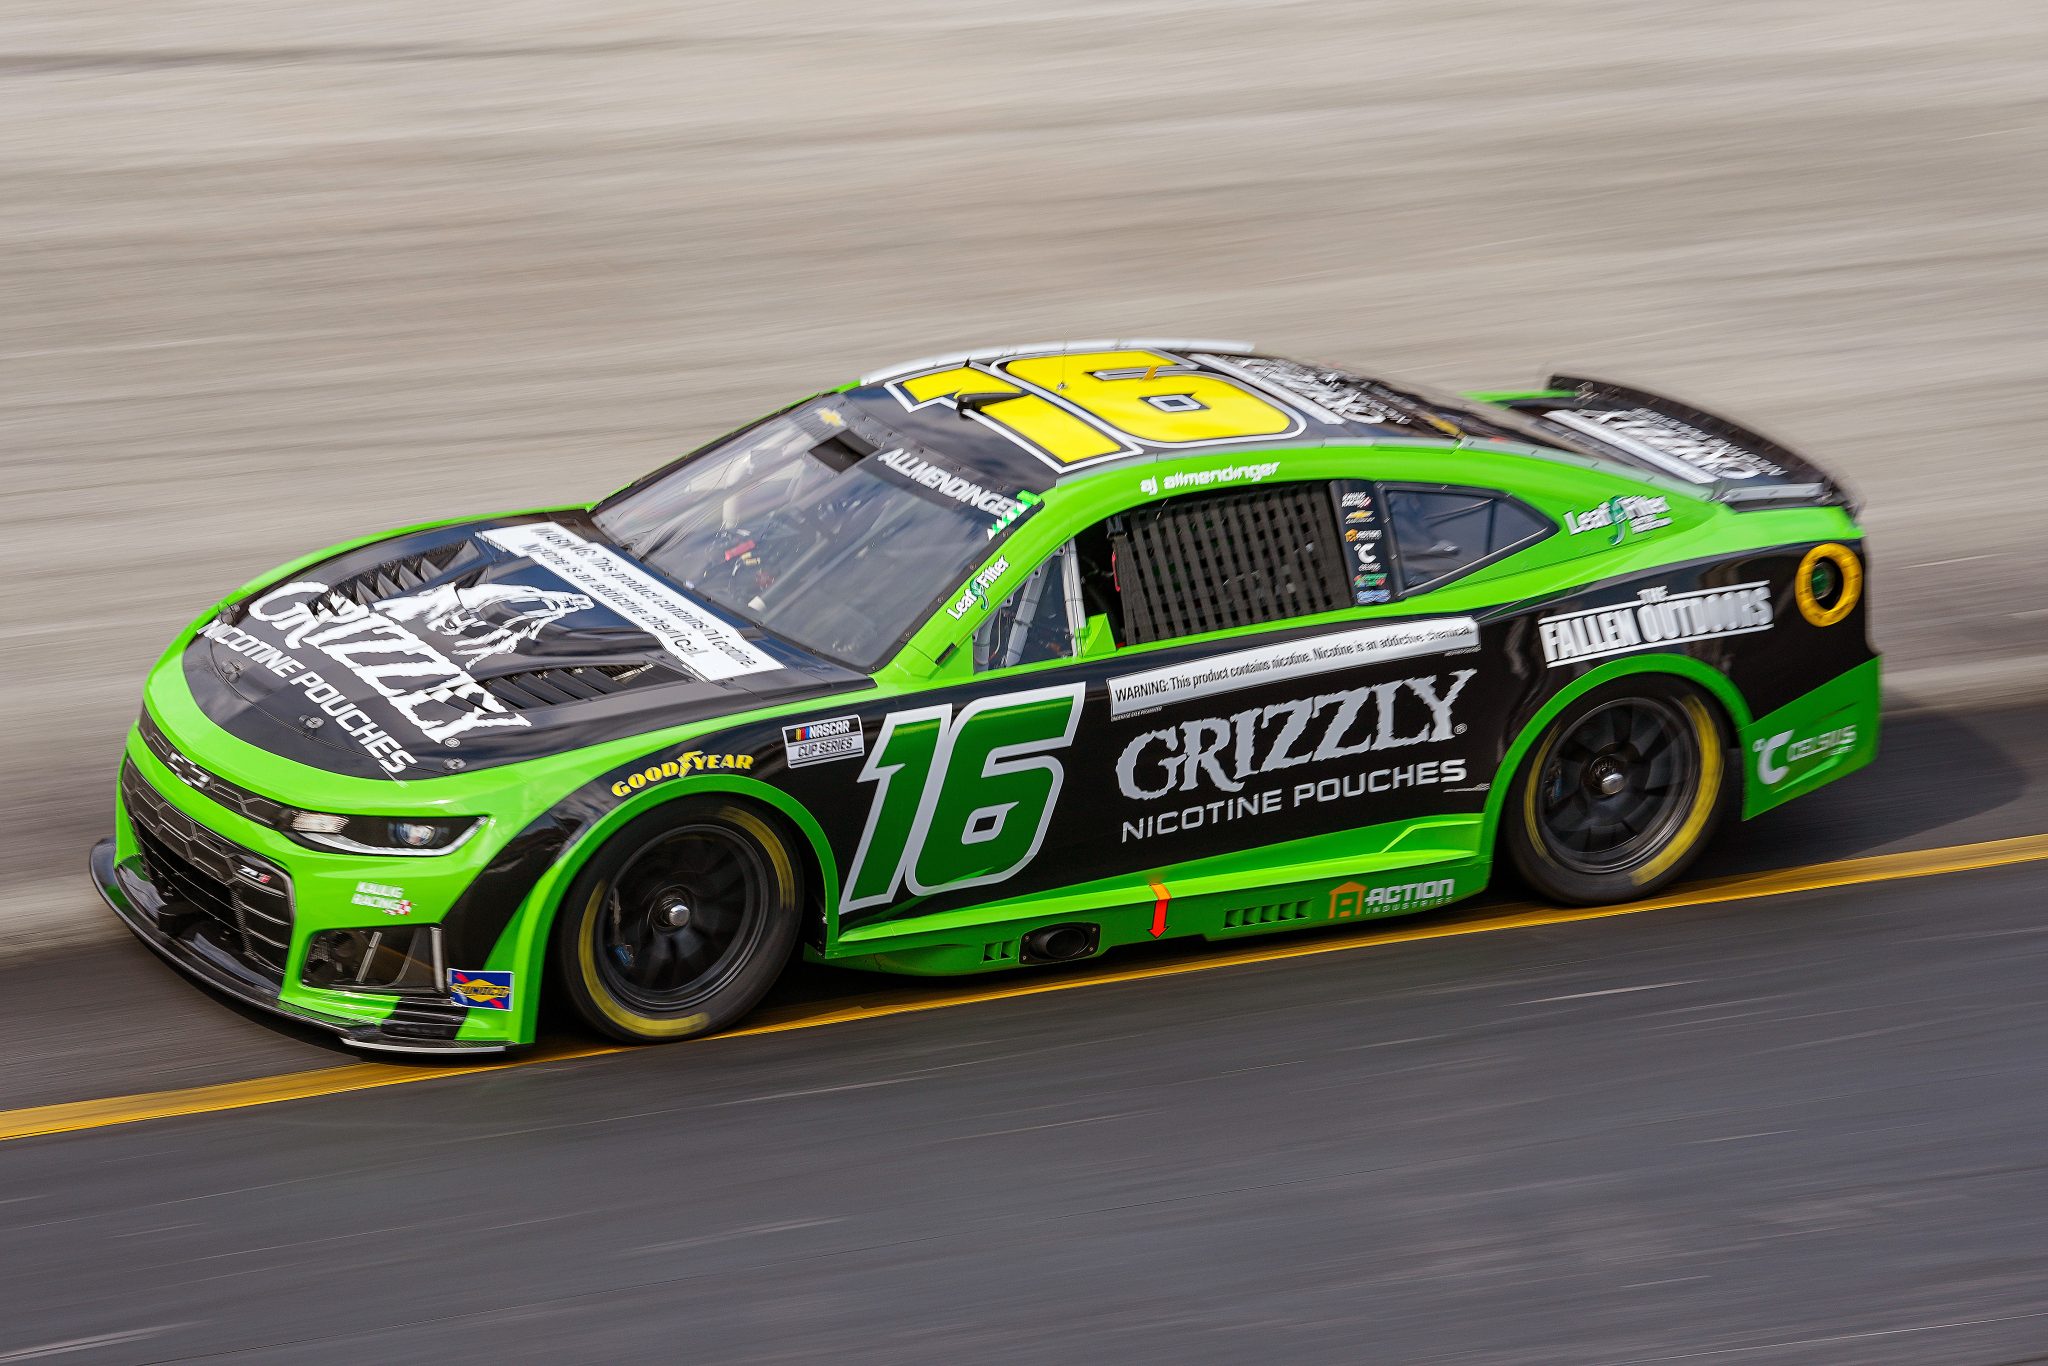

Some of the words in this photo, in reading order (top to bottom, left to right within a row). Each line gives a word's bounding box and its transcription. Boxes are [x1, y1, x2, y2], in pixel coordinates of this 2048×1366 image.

[946, 588, 978, 620] Leaf
[976, 555, 1010, 589] Filter
[1540, 606, 1641, 662] FALLEN
[1636, 586, 1774, 643] OUTDOORS
[249, 581, 532, 743] GRIZZLY
[1115, 679, 1169, 703] WARNING:
[1170, 675, 1191, 690] This
[1193, 668, 1229, 688] product
[1230, 658, 1271, 677] contains
[1312, 643, 1354, 661] Nicotine
[1355, 641, 1364, 652] is
[1365, 639, 1377, 650] an
[1380, 634, 1424, 648] addictive
[197, 620, 305, 678] NICOTINE
[289, 671, 418, 775] POUCHES
[808, 719, 850, 740] NASCAR
[798, 742, 818, 757] CUP
[818, 737, 853, 754] SERIES
[1115, 668, 1477, 800] GRIZZLY
[611, 751, 754, 797] GOODYEAR
[839, 682, 1086, 915] 16
[1121, 788, 1282, 843] NICOTINE
[1294, 758, 1467, 807] POUCHES
[1365, 878, 1455, 906] ACTION
[1366, 897, 1453, 915] INDUSTRIES
